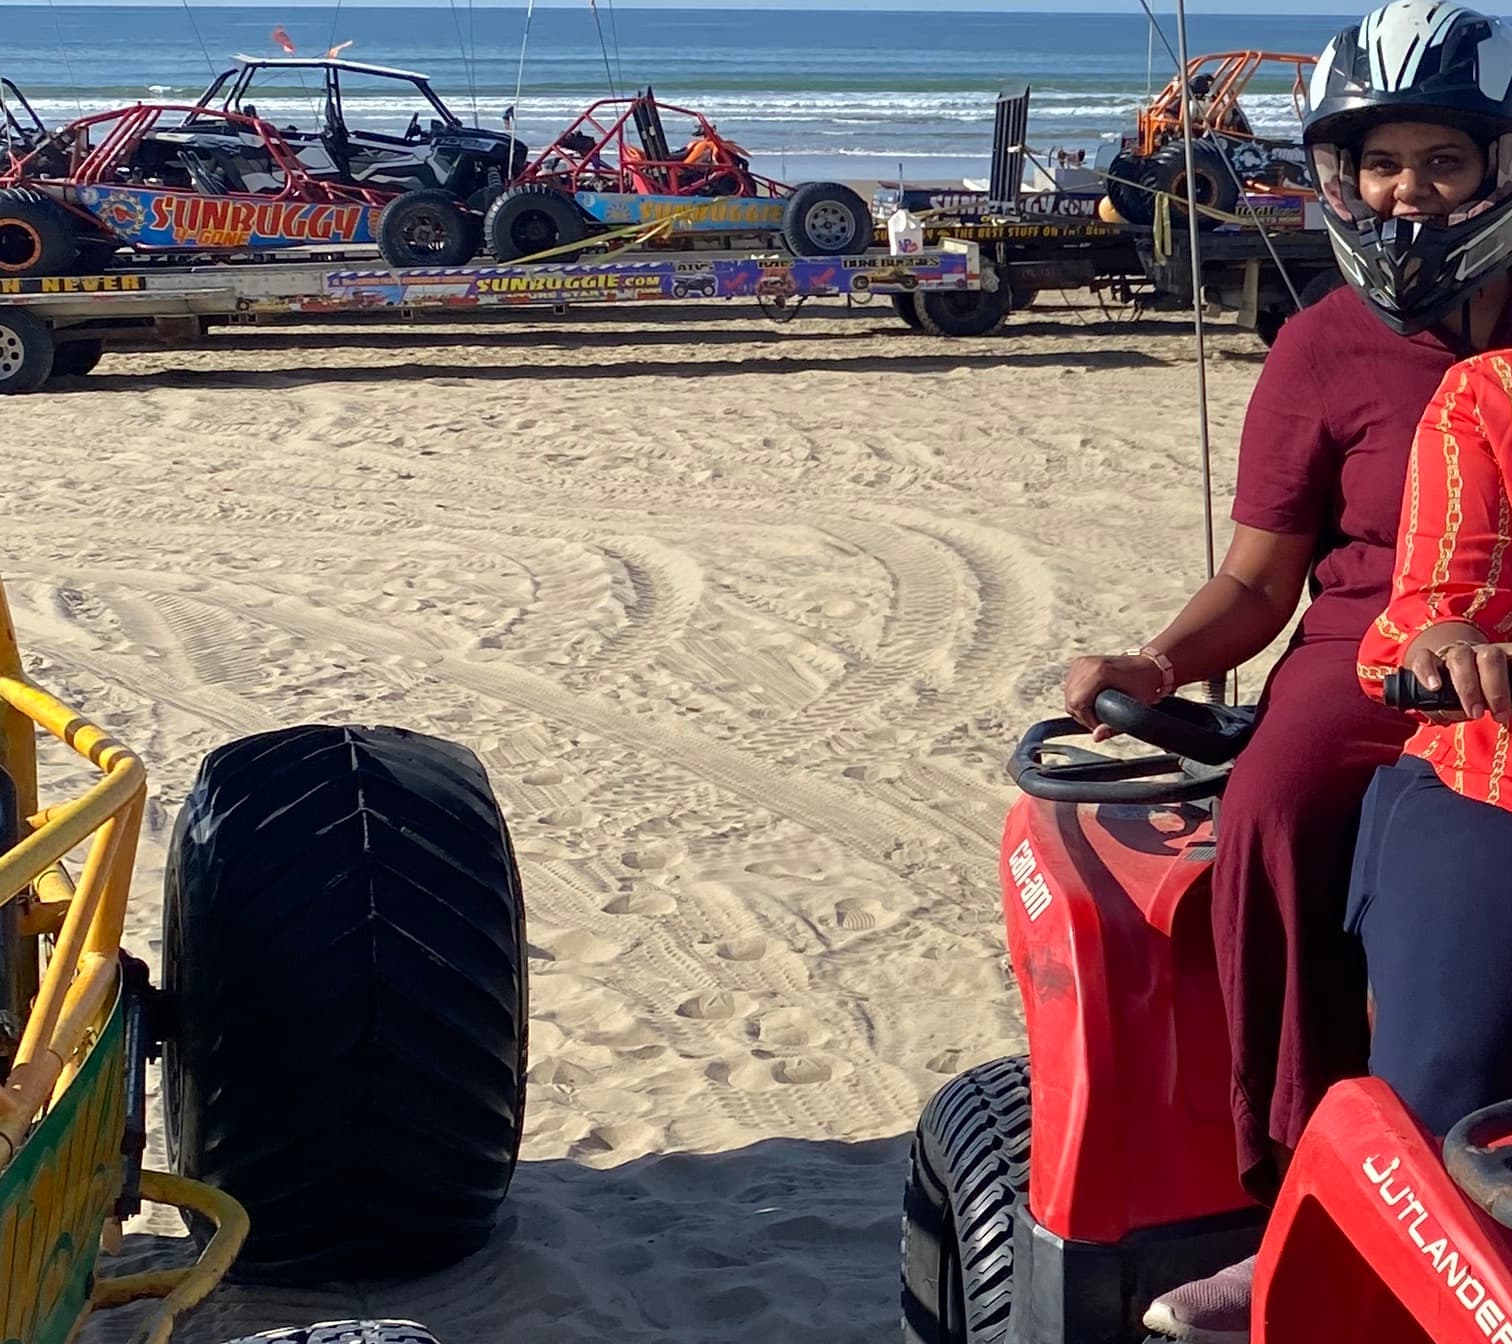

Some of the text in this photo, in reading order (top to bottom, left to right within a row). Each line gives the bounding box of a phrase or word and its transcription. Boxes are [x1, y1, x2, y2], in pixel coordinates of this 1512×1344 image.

[150, 196, 362, 241] SUNBUGGY
[0, 276, 140, 294] N NEVER
[1008, 838, 1053, 922] can-am
